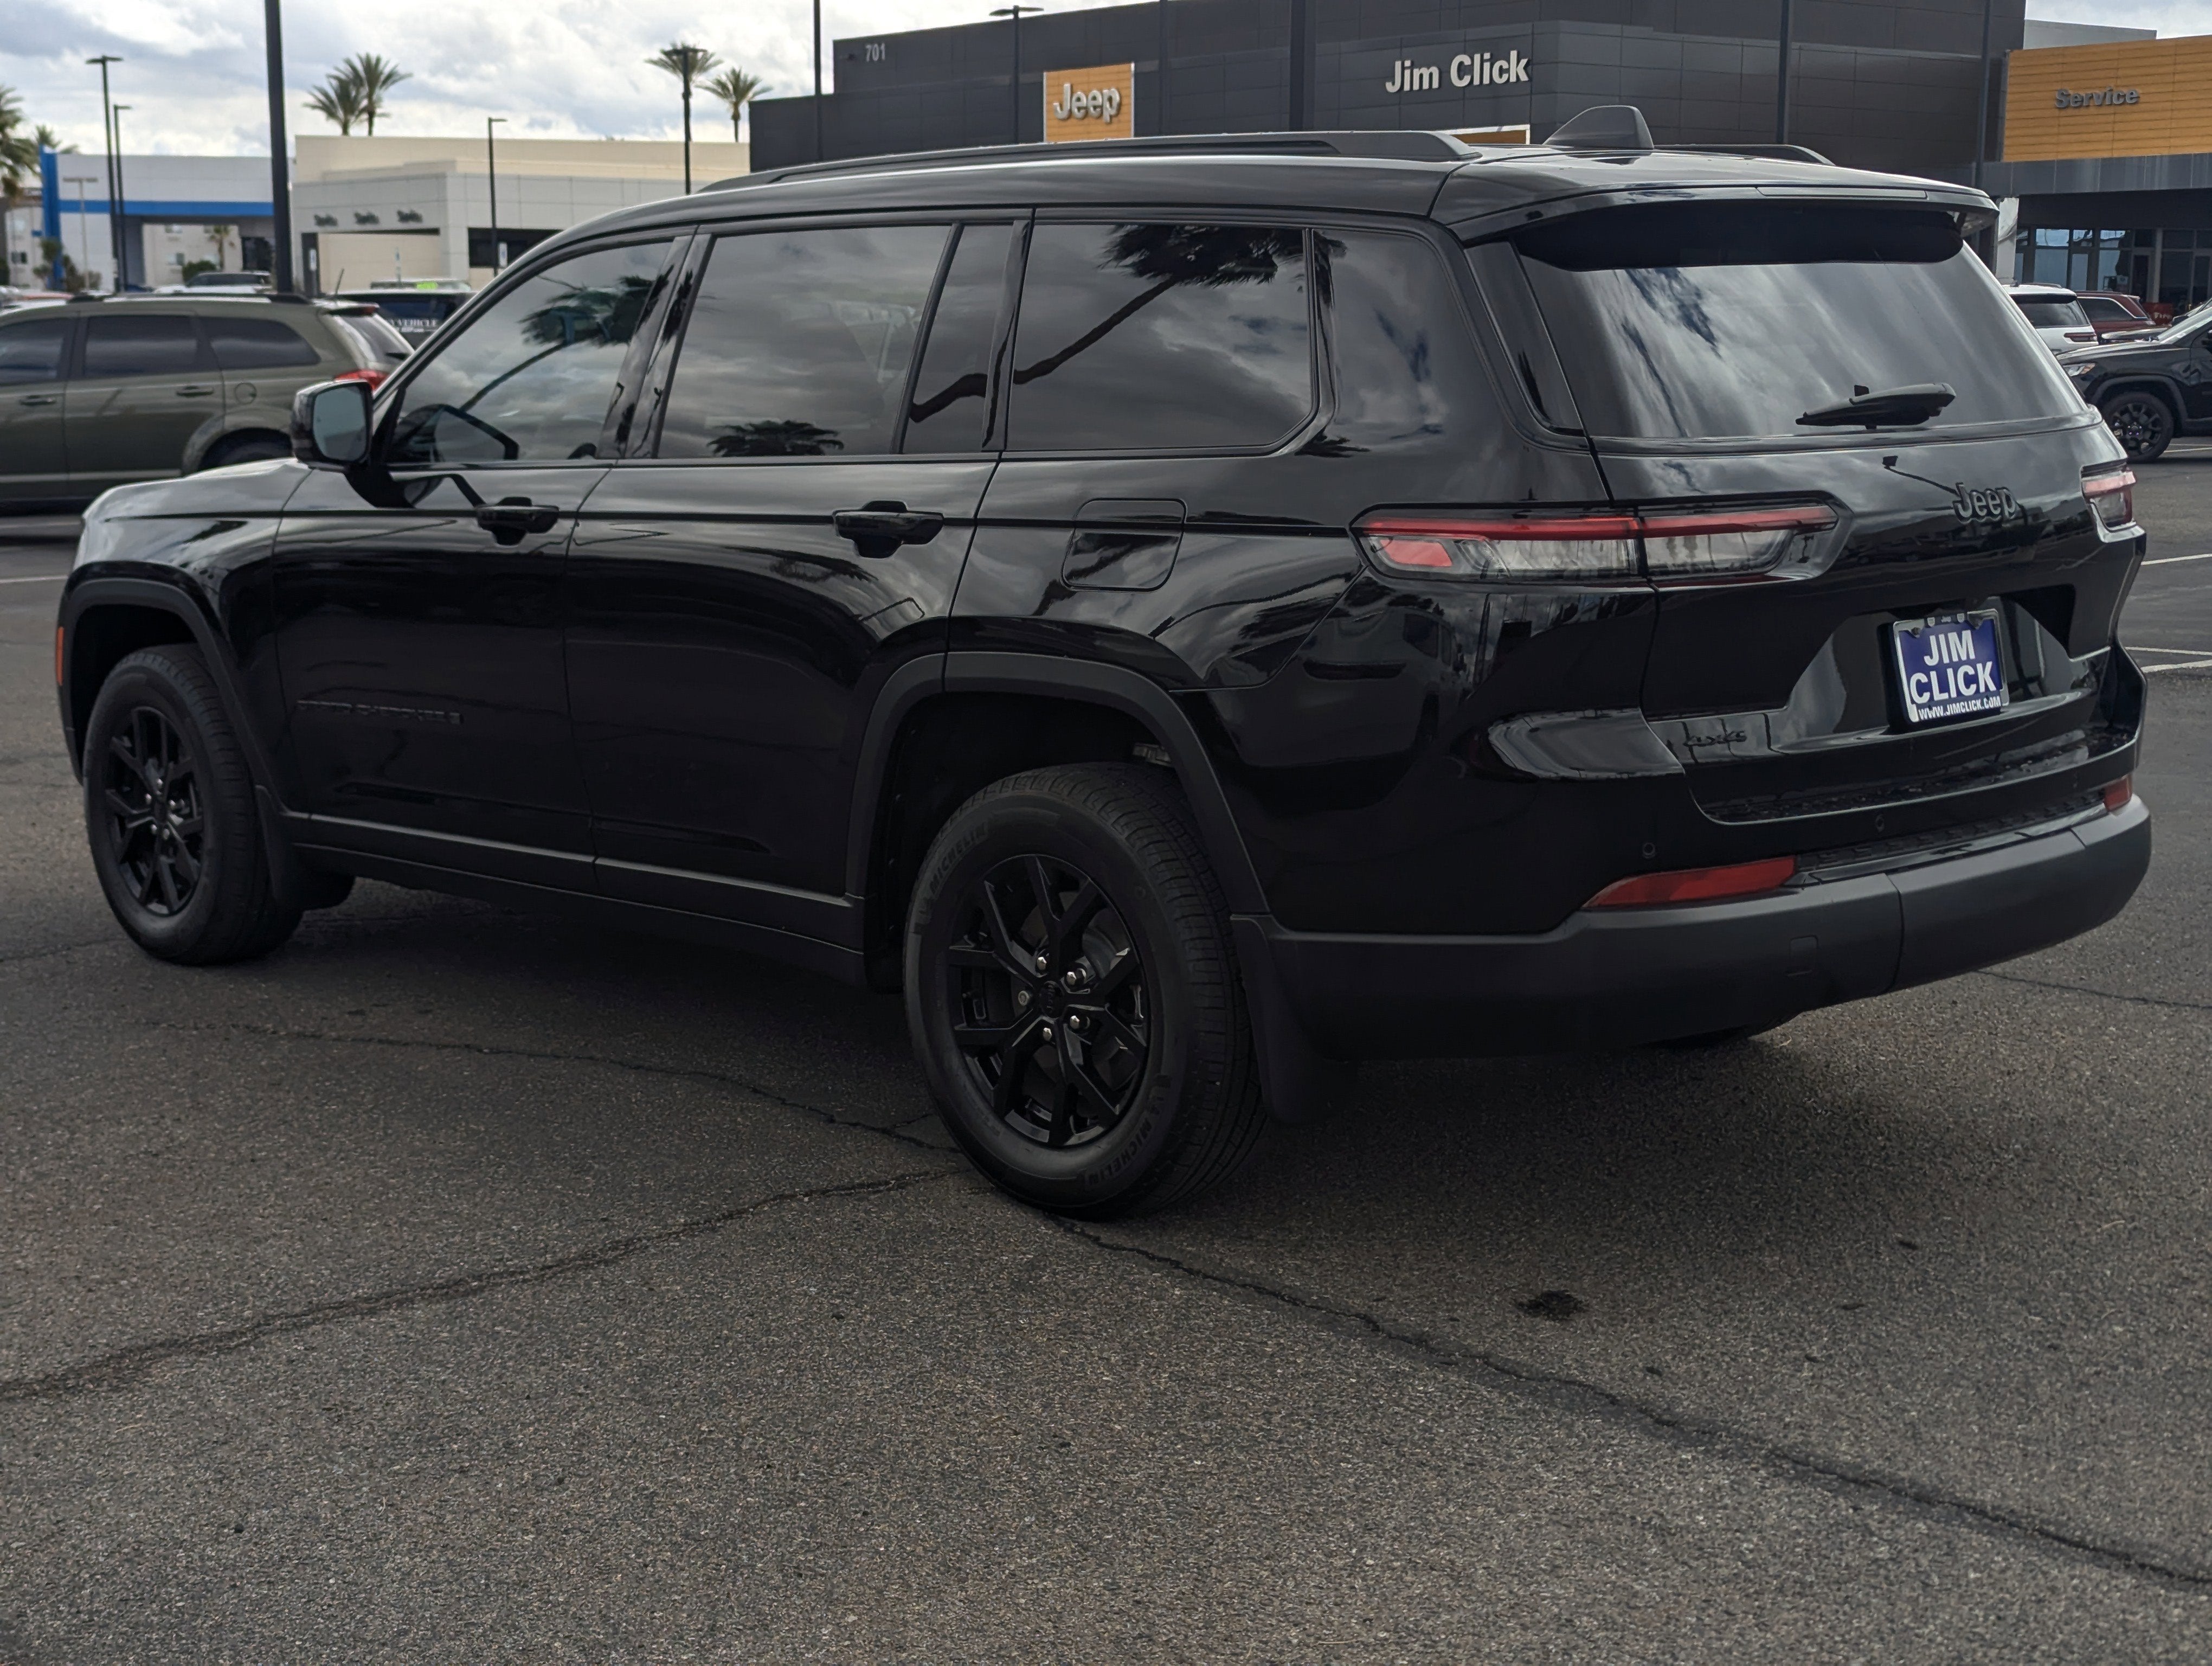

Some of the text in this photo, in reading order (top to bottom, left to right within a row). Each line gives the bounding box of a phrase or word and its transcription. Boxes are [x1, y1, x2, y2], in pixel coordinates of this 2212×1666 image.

[865, 43, 885, 62] 701
[1386, 49, 1529, 93] Jim Click
[1053, 83, 1121, 123] Jeep
[2055, 86, 2140, 108] Service
[1952, 482, 2016, 523] Jeep
[1924, 630, 1976, 666] JIM
[1910, 661, 1997, 704] CLICK
[1918, 696, 2001, 721] WWW.JIMCLICK.COM
[929, 822, 988, 896] MICHELIN
[1087, 1117, 1153, 1186] MICHELIN
